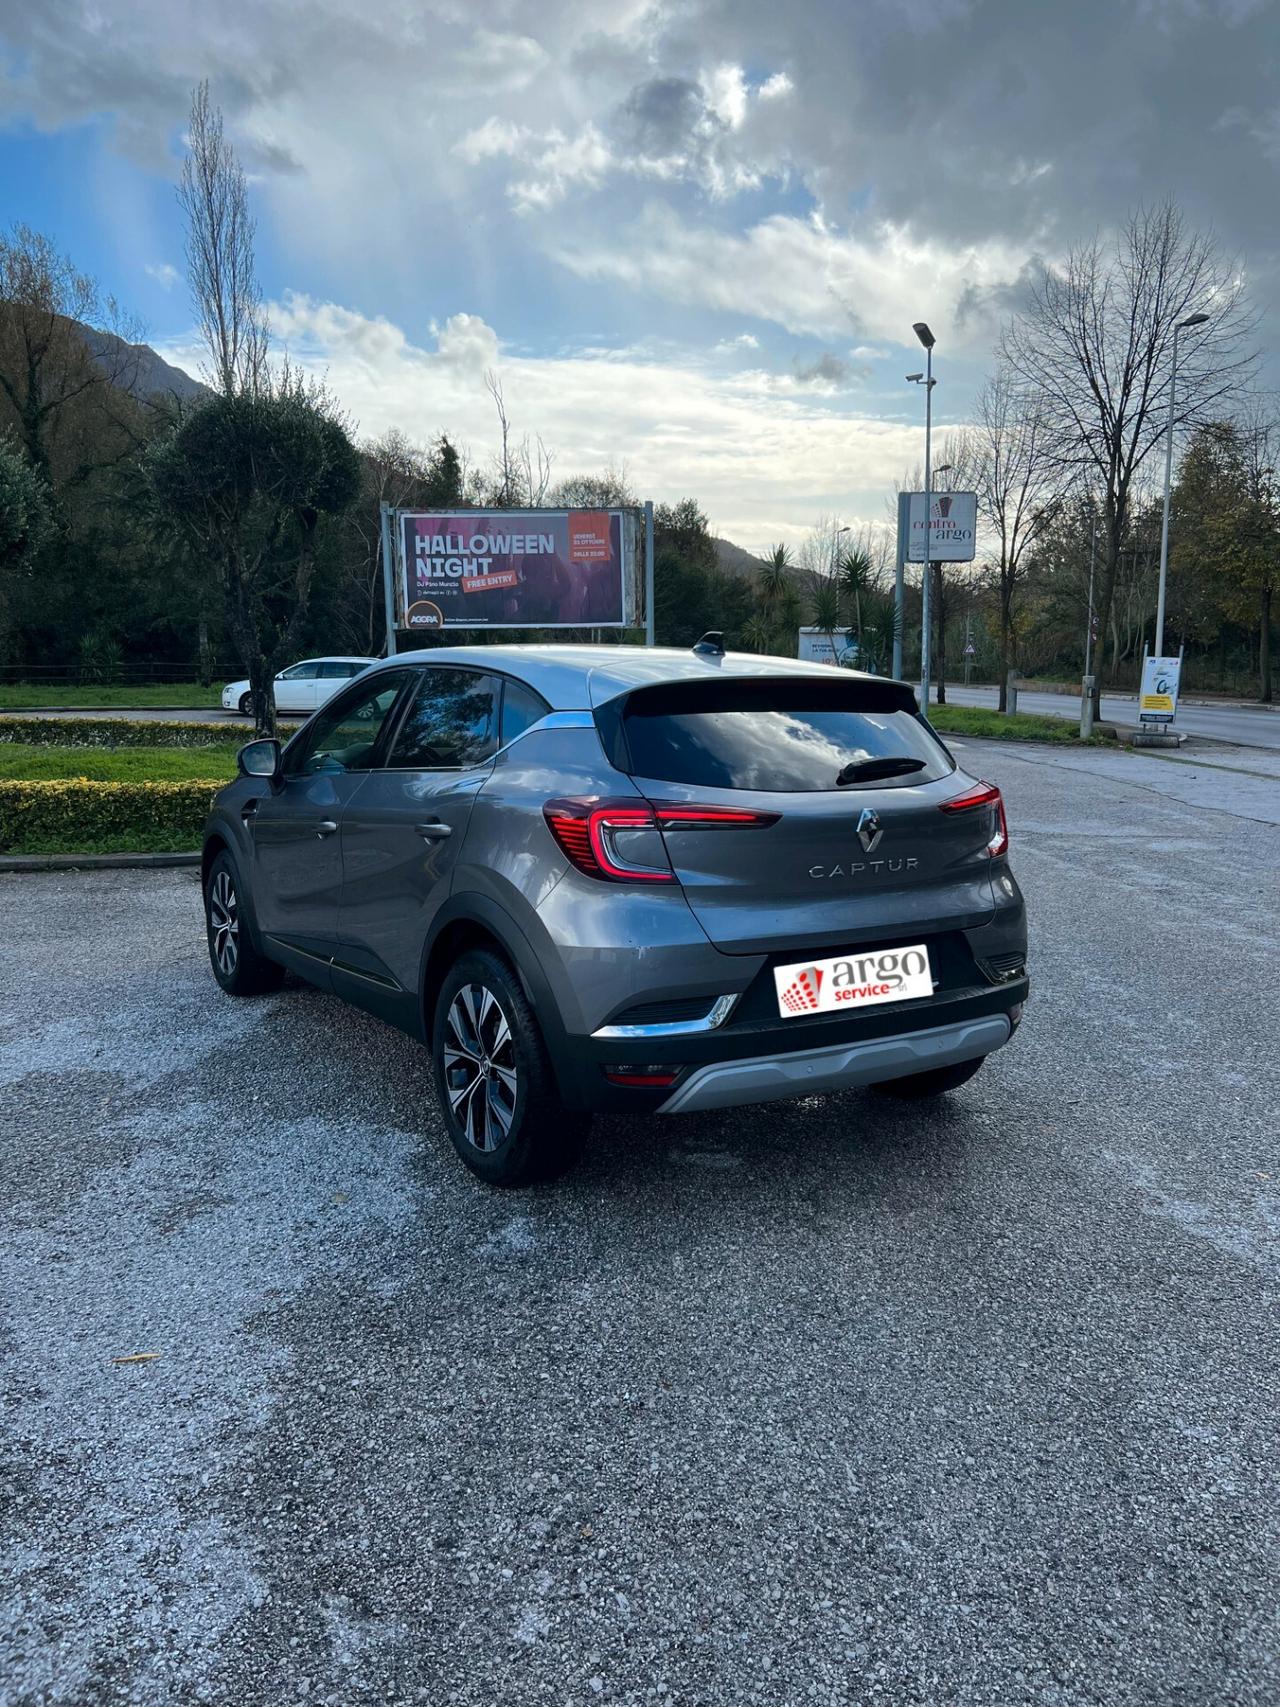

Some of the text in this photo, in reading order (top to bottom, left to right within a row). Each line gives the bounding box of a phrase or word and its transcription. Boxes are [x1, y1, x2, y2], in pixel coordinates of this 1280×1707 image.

[415, 534, 554, 556] HALLOWEEN
[936, 528, 972, 542] argo
[416, 558, 492, 578] NIGHT
[467, 575, 512, 588] FREE ENTRY
[808, 857, 920, 879] CAPTUR
